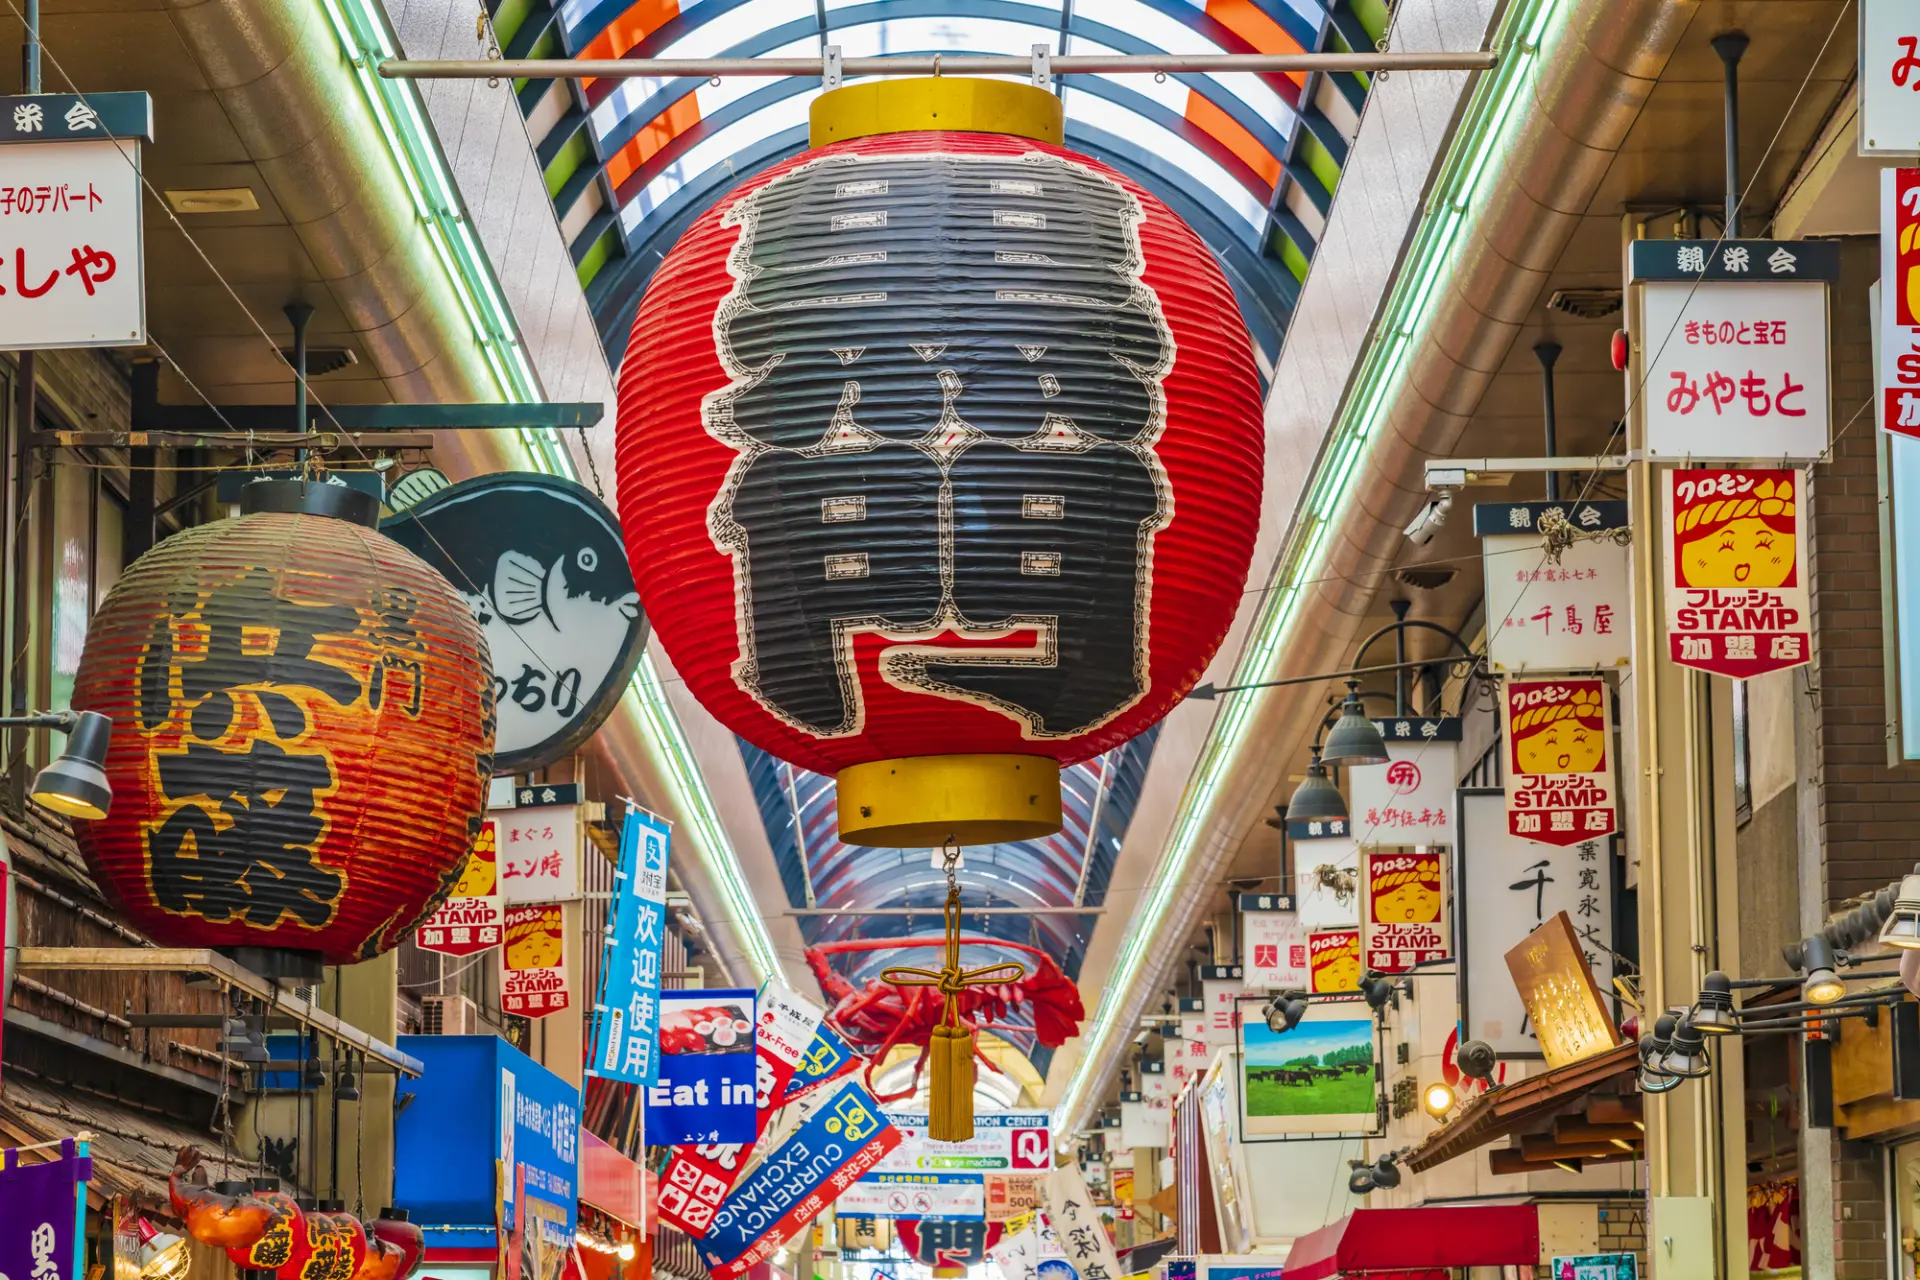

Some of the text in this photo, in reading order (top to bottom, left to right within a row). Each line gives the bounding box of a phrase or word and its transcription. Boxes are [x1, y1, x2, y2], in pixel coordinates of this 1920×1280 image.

[0, 244, 117, 299] しや
[1677, 247, 1798, 274] 親栄会
[1684, 320, 1787, 346] きものと宝石
[1667, 369, 1807, 417] みやもと
[1676, 474, 1755, 504] クロモン
[1686, 589, 1784, 609] フレッシュ
[1531, 604, 1615, 636] 千鳥屋
[1677, 608, 1799, 631] STAMP
[1679, 635, 1801, 661] 加盟店
[1511, 686, 1572, 711] クロモン
[1521, 774, 1596, 790] フレッシュ
[1514, 789, 1607, 808] STAMP
[1516, 810, 1609, 833] 加盟店
[508, 826, 554, 843] まぐろ
[1372, 857, 1417, 876] クロモン
[504, 908, 542, 926] クロモン
[423, 927, 498, 945] 加盟店
[1377, 923, 1433, 935] フレッシュ
[1311, 935, 1349, 952] クロモン
[1372, 935, 1442, 949] STAMP
[505, 978, 564, 993] STAMP
[509, 969, 557, 980] フレッシュ
[506, 991, 565, 1010] 加盟店
[621, 904, 659, 1078] 欢迎使用
[756, 1023, 801, 1060] Tax-Free
[649, 1078, 709, 1107] Eat
[721, 1077, 754, 1106] in
[1004, 1115, 1045, 1126] CENTER
[708, 1141, 811, 1240] EXCHANGE
[738, 1142, 844, 1243] CURRENCY
[31, 1222, 60, 1280] 黒
